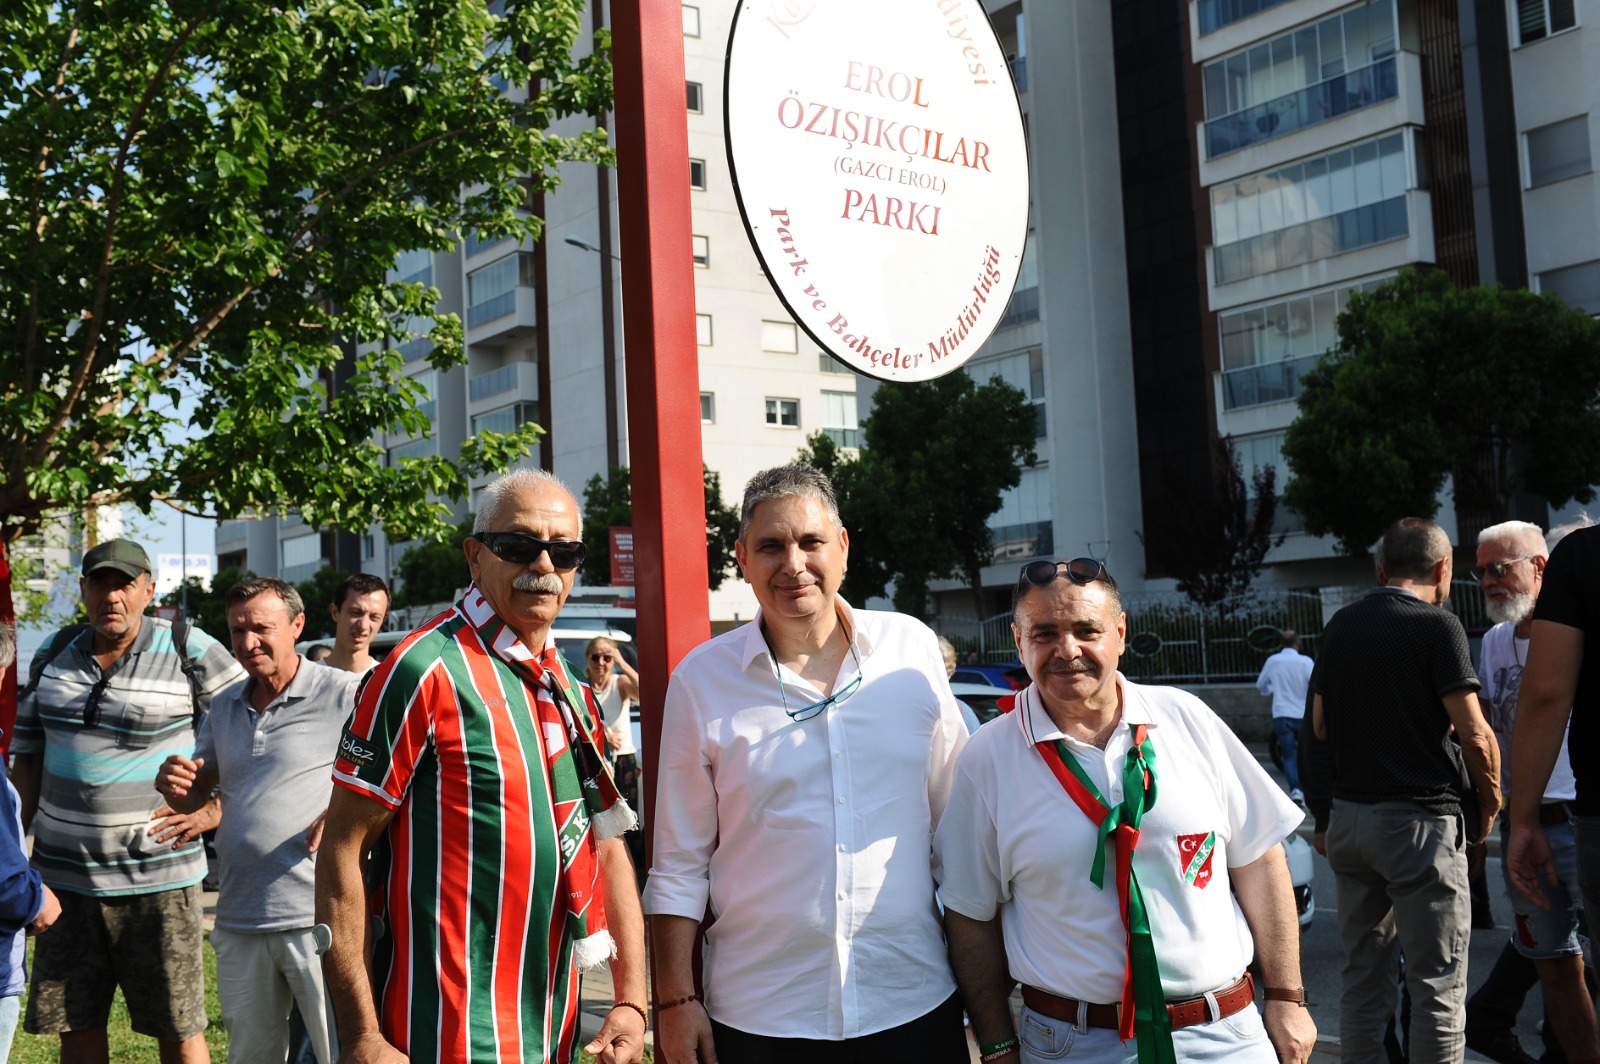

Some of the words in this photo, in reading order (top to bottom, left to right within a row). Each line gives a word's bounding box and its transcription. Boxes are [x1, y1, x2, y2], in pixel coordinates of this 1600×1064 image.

[844, 60, 929, 108] EROL
[777, 89, 992, 173] ÖZIŞIKÇILAR
[834, 155, 893, 182] (GAZCI
[899, 169, 946, 195] EROL)
[840, 188, 942, 236] PARKI
[769, 206, 809, 277] Park
[803, 283, 827, 312] ve
[826, 311, 923, 369] Bahçeler
[927, 244, 1001, 364] Müdürlüğü
